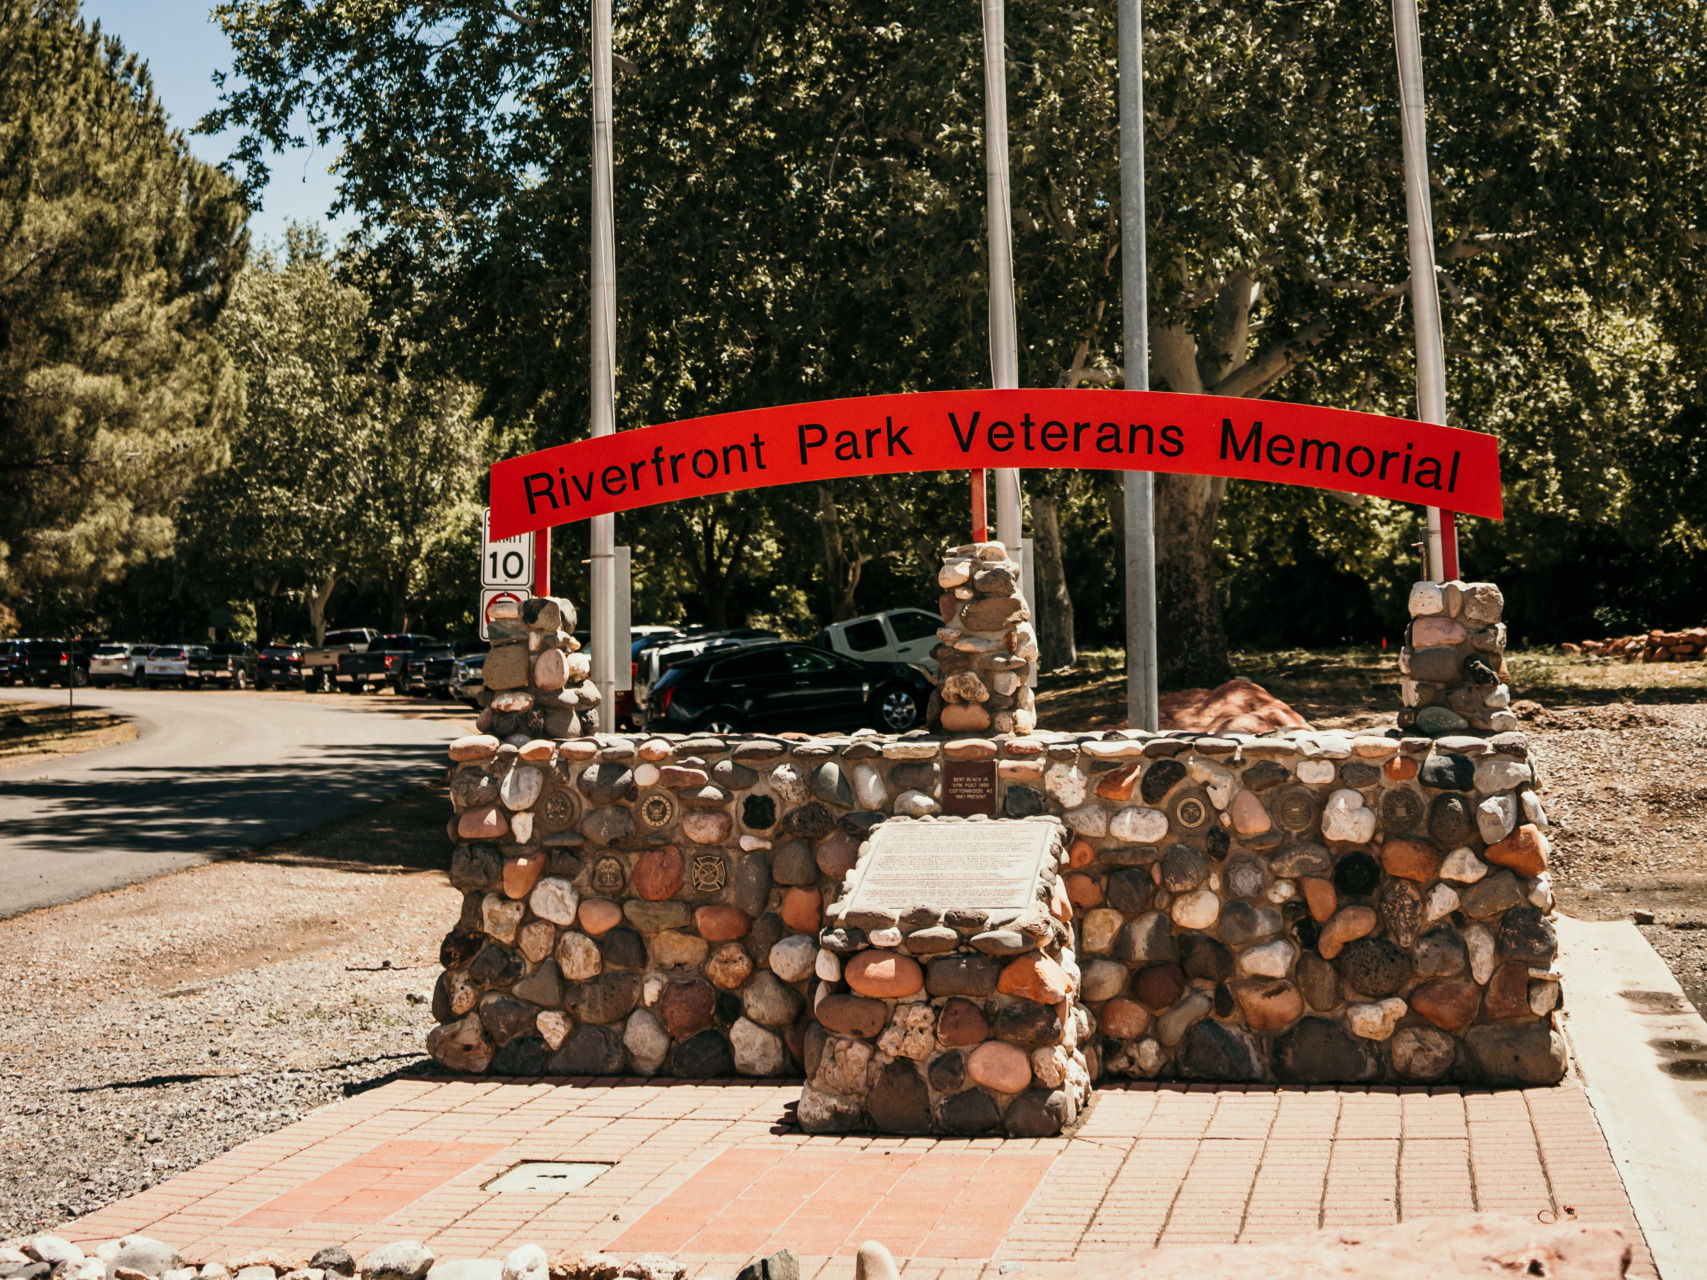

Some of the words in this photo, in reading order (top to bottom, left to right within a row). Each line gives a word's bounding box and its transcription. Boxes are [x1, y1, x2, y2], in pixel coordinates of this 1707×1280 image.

[524, 434, 766, 514] Riverfront
[798, 417, 914, 465] Park
[948, 412, 1184, 457] Veterans
[1220, 419, 1460, 492] Memorial
[489, 551, 524, 579] 10
